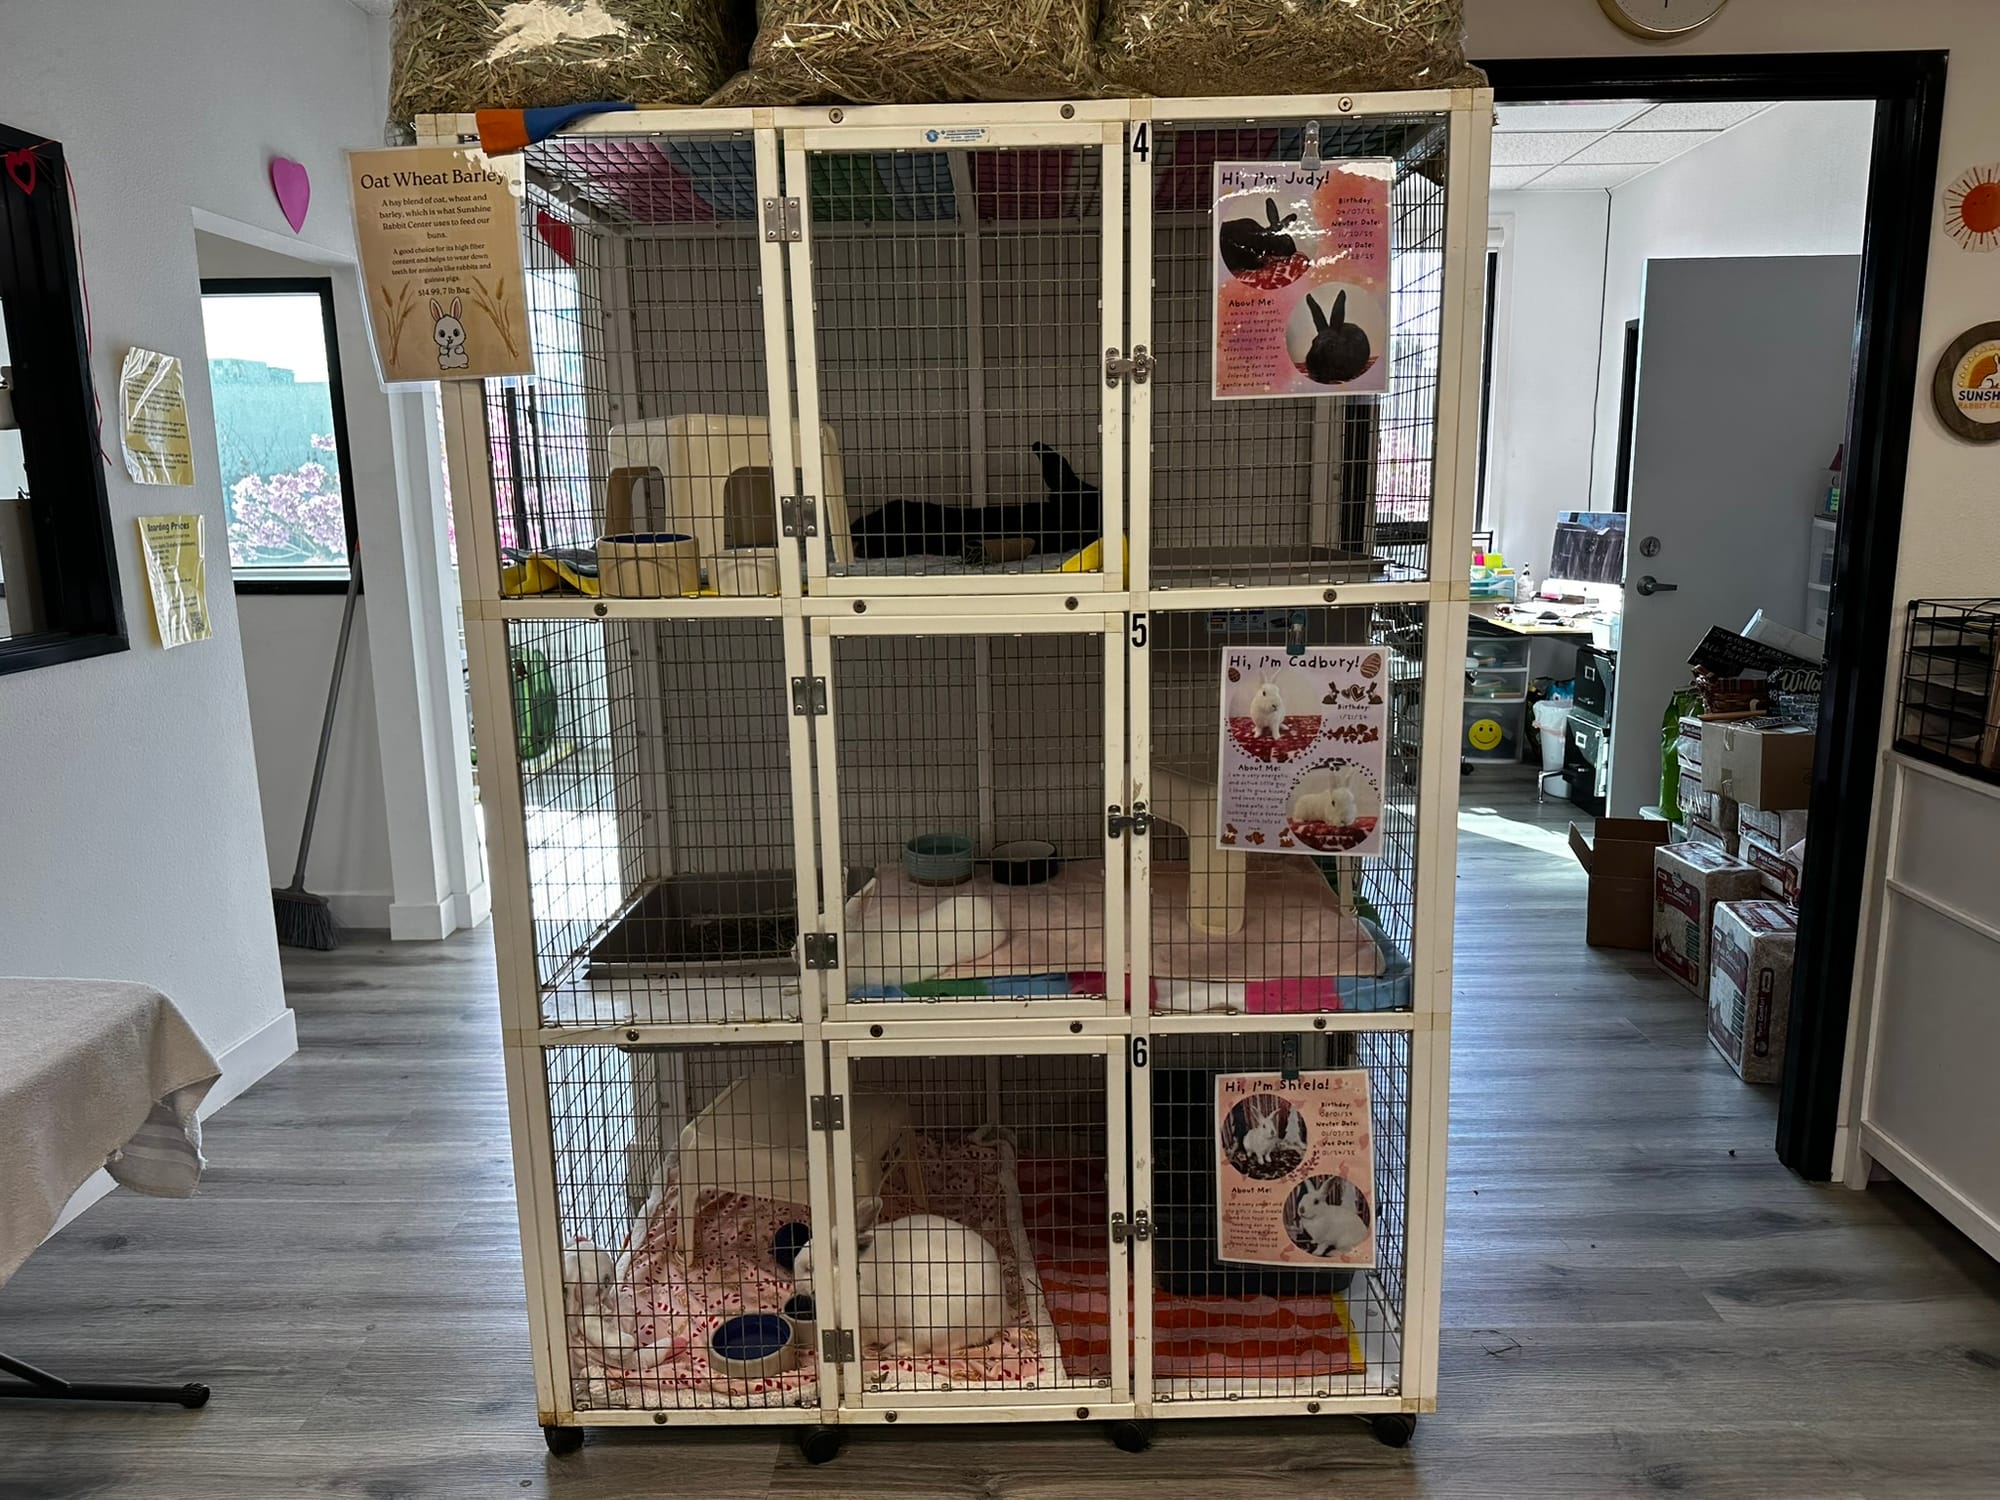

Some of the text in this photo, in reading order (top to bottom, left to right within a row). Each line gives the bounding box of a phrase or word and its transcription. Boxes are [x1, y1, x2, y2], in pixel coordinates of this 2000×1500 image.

[1133, 123, 1149, 162] 4
[360, 169, 505, 188] Oat Wheat Barley
[1222, 172, 1245, 189] Hi,
[1285, 170, 1329, 190] Judy!
[389, 199, 402, 208] hay
[448, 195, 472, 203] wheat
[406, 209, 428, 217] which
[437, 207, 456, 215] what
[457, 205, 491, 214] Sunshine
[383, 222, 406, 231] Rabbit
[408, 221, 432, 229] Center
[399, 248, 414, 256] good
[455, 244, 469, 252] high
[457, 287, 470, 295] Bag
[1229, 299, 1255, 308] About
[1959, 390, 2000, 401] SUNSH
[1131, 613, 1147, 648] 5
[1230, 655, 1360, 673] Hi, I'm Cadbury!
[1780, 671, 1821, 693] Willo
[1132, 1037, 1148, 1068] 6
[1225, 1081, 1245, 1094] Hi,
[1253, 1081, 1273, 1092] I'm
